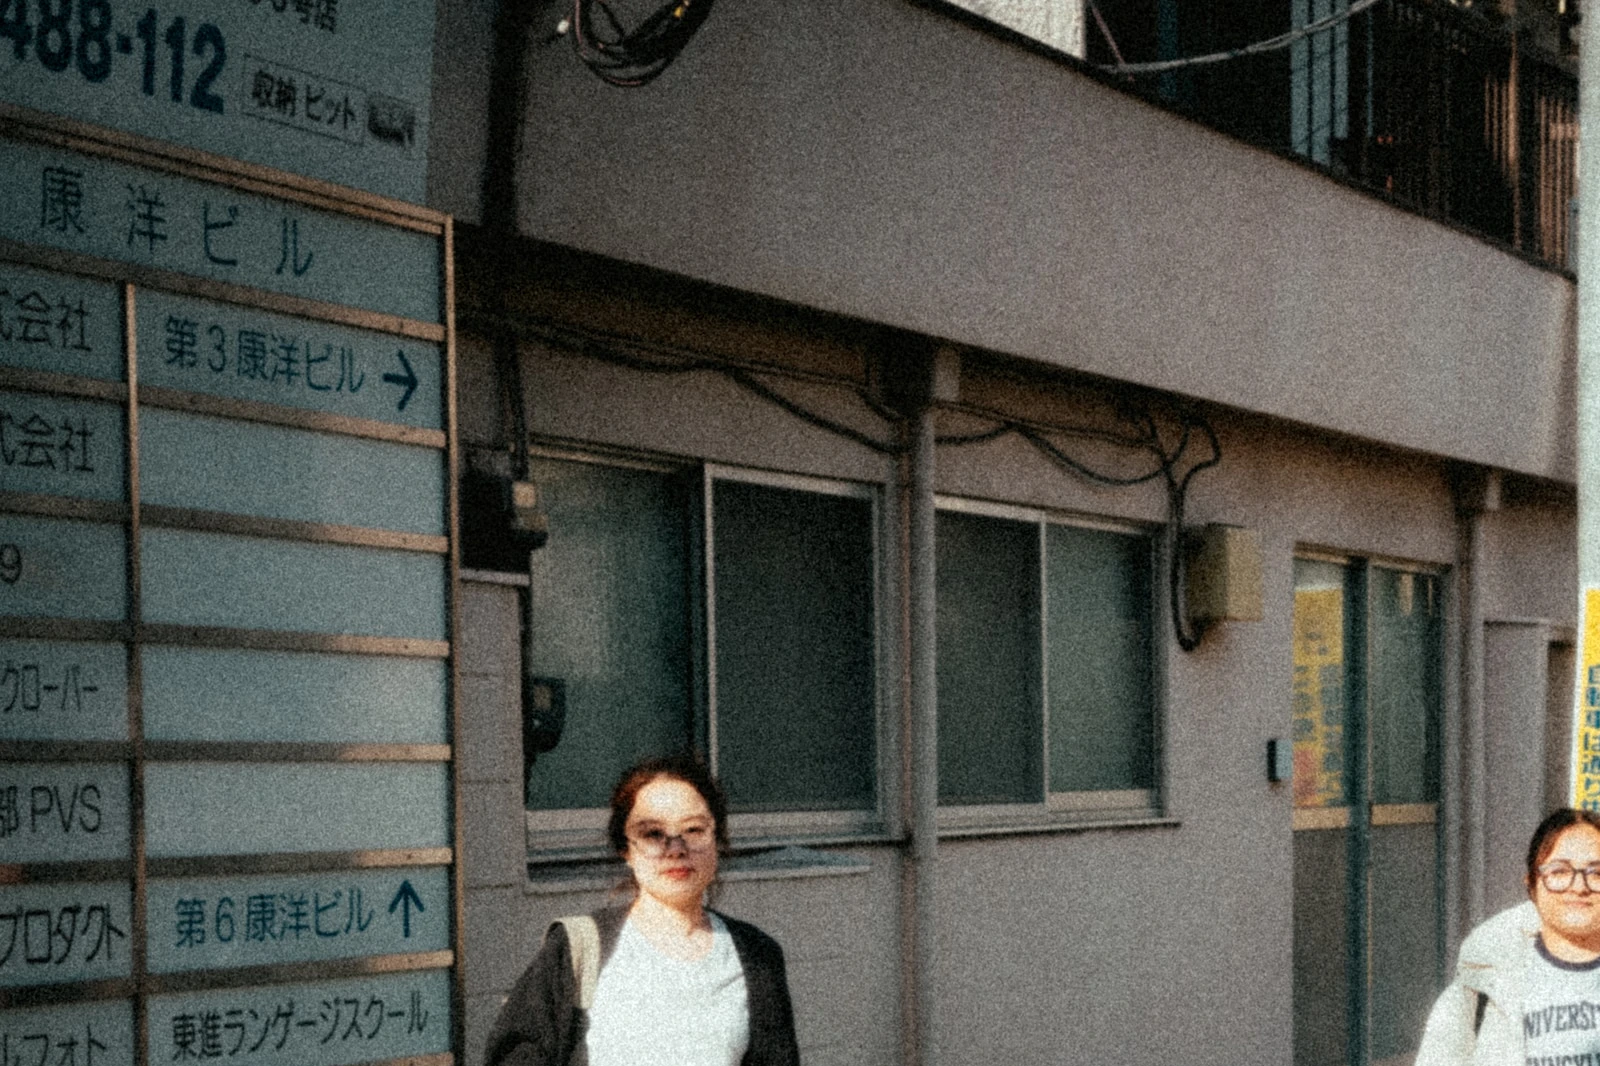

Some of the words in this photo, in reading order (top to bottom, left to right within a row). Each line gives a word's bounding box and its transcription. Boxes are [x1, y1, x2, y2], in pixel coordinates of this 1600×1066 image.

[40, 166, 314, 277] 康洋ビル
[164, 315, 364, 394] 第3康洋ビル
[31, 783, 101, 833] PVS
[175, 888, 374, 949] 第6康洋ビル
